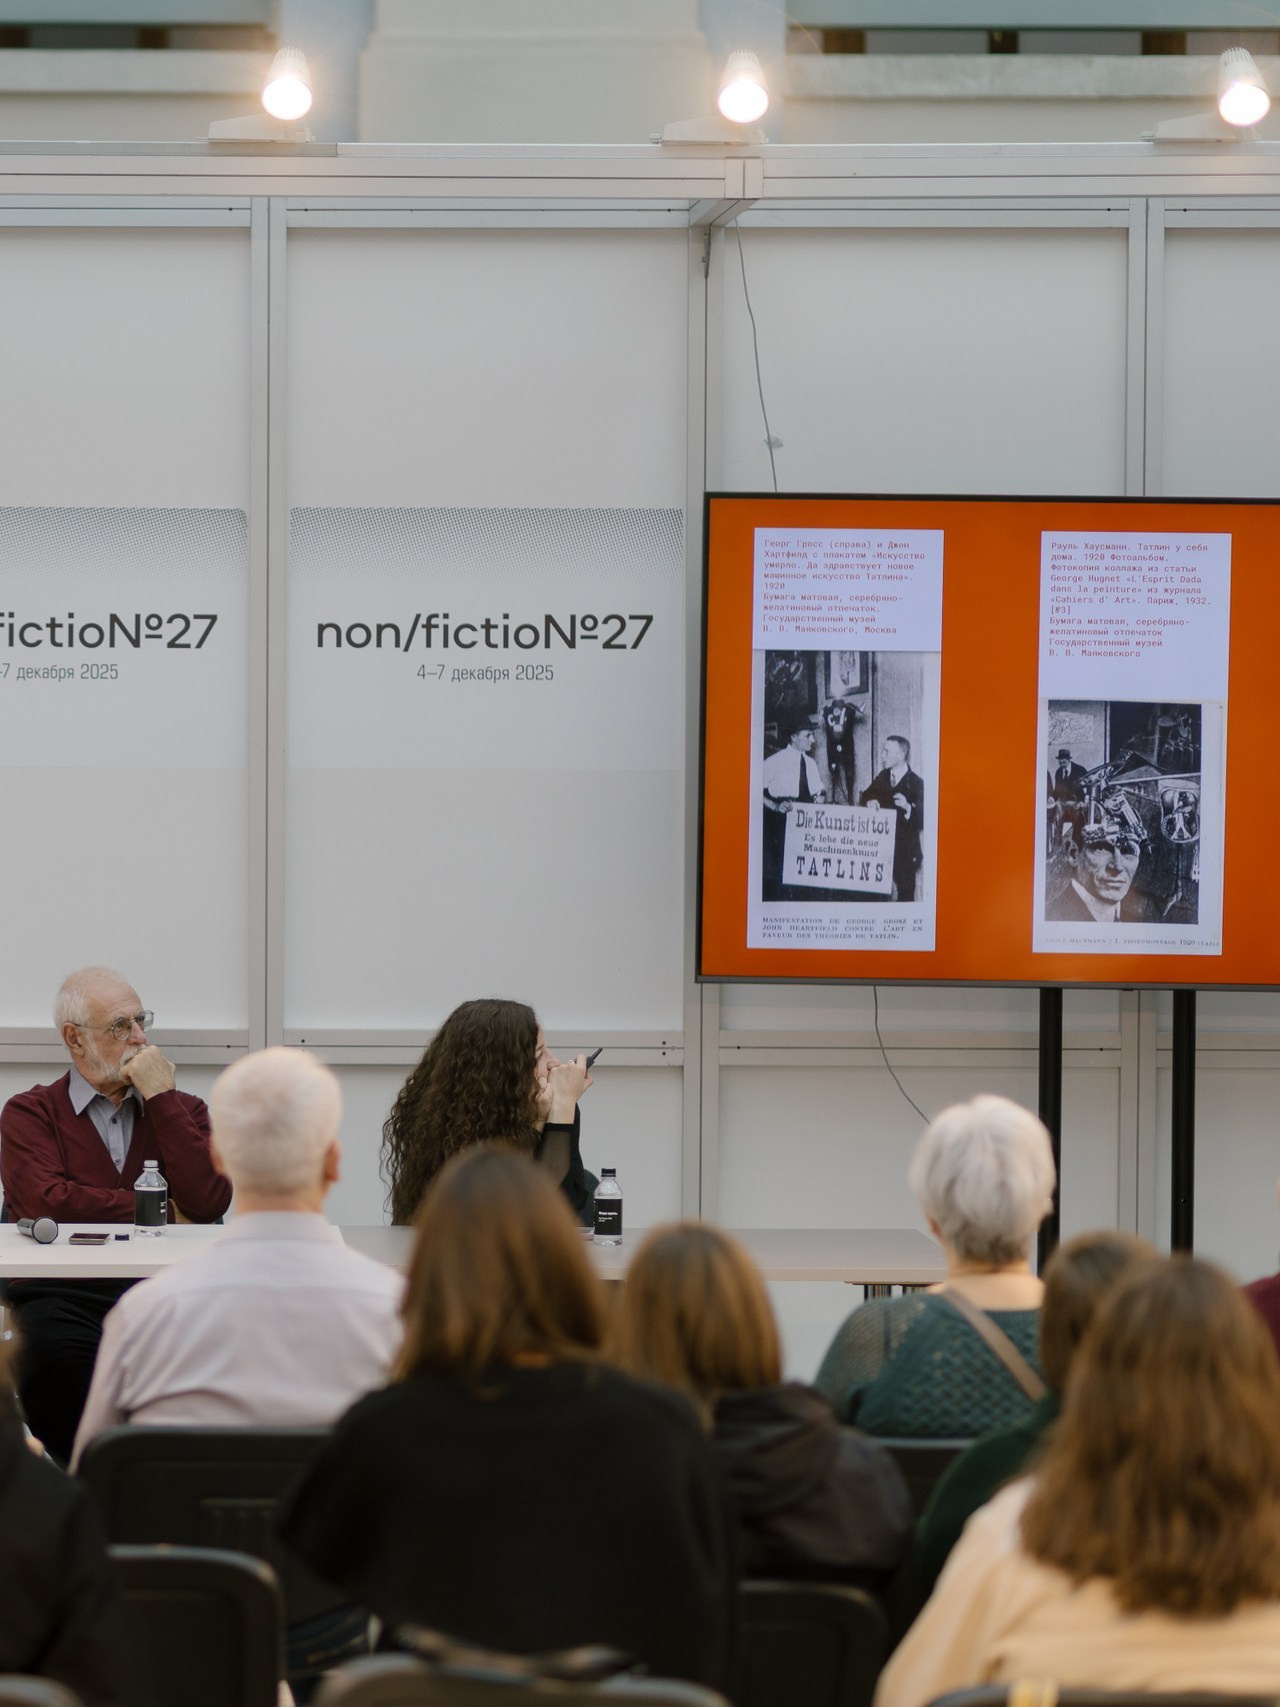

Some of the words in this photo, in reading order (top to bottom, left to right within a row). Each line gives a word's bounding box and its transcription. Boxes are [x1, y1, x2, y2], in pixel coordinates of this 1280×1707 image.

[765, 540, 791, 549] Георг
[797, 541, 823, 549] Гросс
[829, 540, 870, 549] (справа)
[888, 541, 908, 550] Джон
[1052, 543, 1078, 551] Рауль
[764, 551, 807, 559] Хартфилд
[807, 562, 817, 570] Да
[1051, 564, 1099, 572] Фотокопия
[1051, 575, 1083, 583] George
[1089, 575, 1120, 584] Hugnet
[764, 594, 795, 602] Бумага
[764, 615, 843, 623] Государственный
[849, 615, 875, 624] музей
[1050, 617, 1082, 626] Бумага
[1050, 639, 1130, 647] Государственный
[1136, 639, 1162, 648] музей
[17, 665, 74, 682] декабря
[80, 664, 118, 680] 2025
[452, 666, 509, 683] декабря
[515, 665, 553, 680] 2025
[796, 809, 812, 828] Die
[815, 811, 856, 832] Kunst
[872, 816, 889, 834] tot
[804, 833, 815, 842] Es
[820, 834, 836, 844] lebe
[841, 836, 854, 845] die
[803, 844, 878, 857] Maschinenkunst
[796, 856, 884, 882] TATLINS
